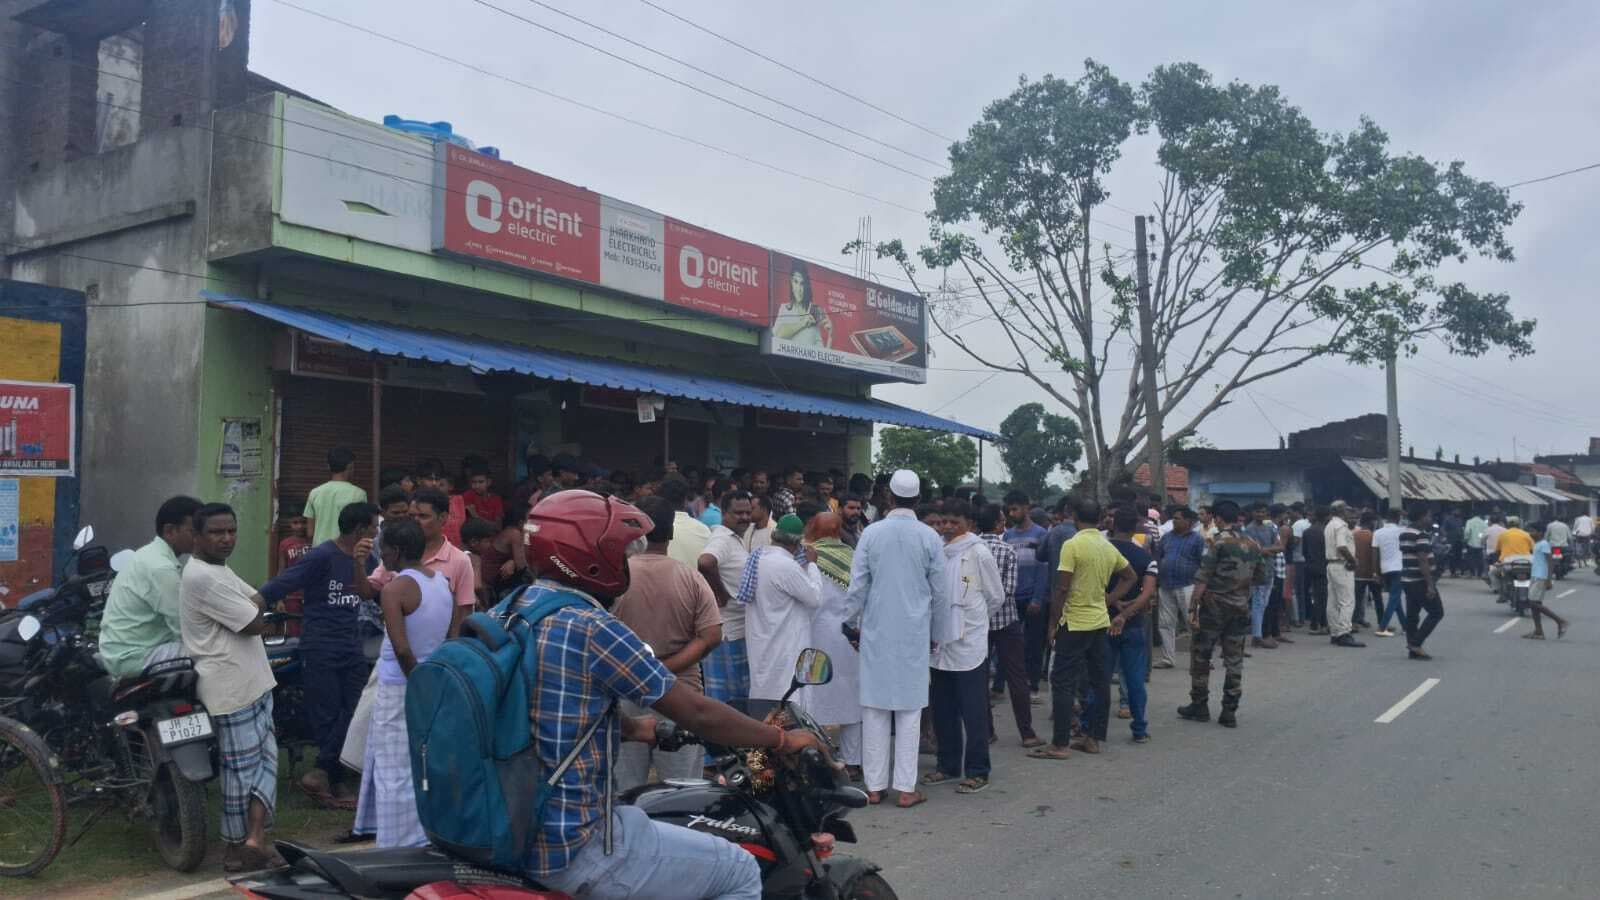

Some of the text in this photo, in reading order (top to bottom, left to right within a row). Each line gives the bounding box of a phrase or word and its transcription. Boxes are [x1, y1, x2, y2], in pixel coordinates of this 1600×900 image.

[508, 197, 583, 237] orient
[508, 221, 558, 246] electric
[608, 238, 657, 260] ELECTRICALS
[707, 255, 759, 287] orient
[707, 278, 741, 296] electric
[877, 290, 919, 320] Goldmedal
[328, 579, 344, 591] Be
[169, 719, 182, 730] JH
[169, 725, 203, 740] P1027
